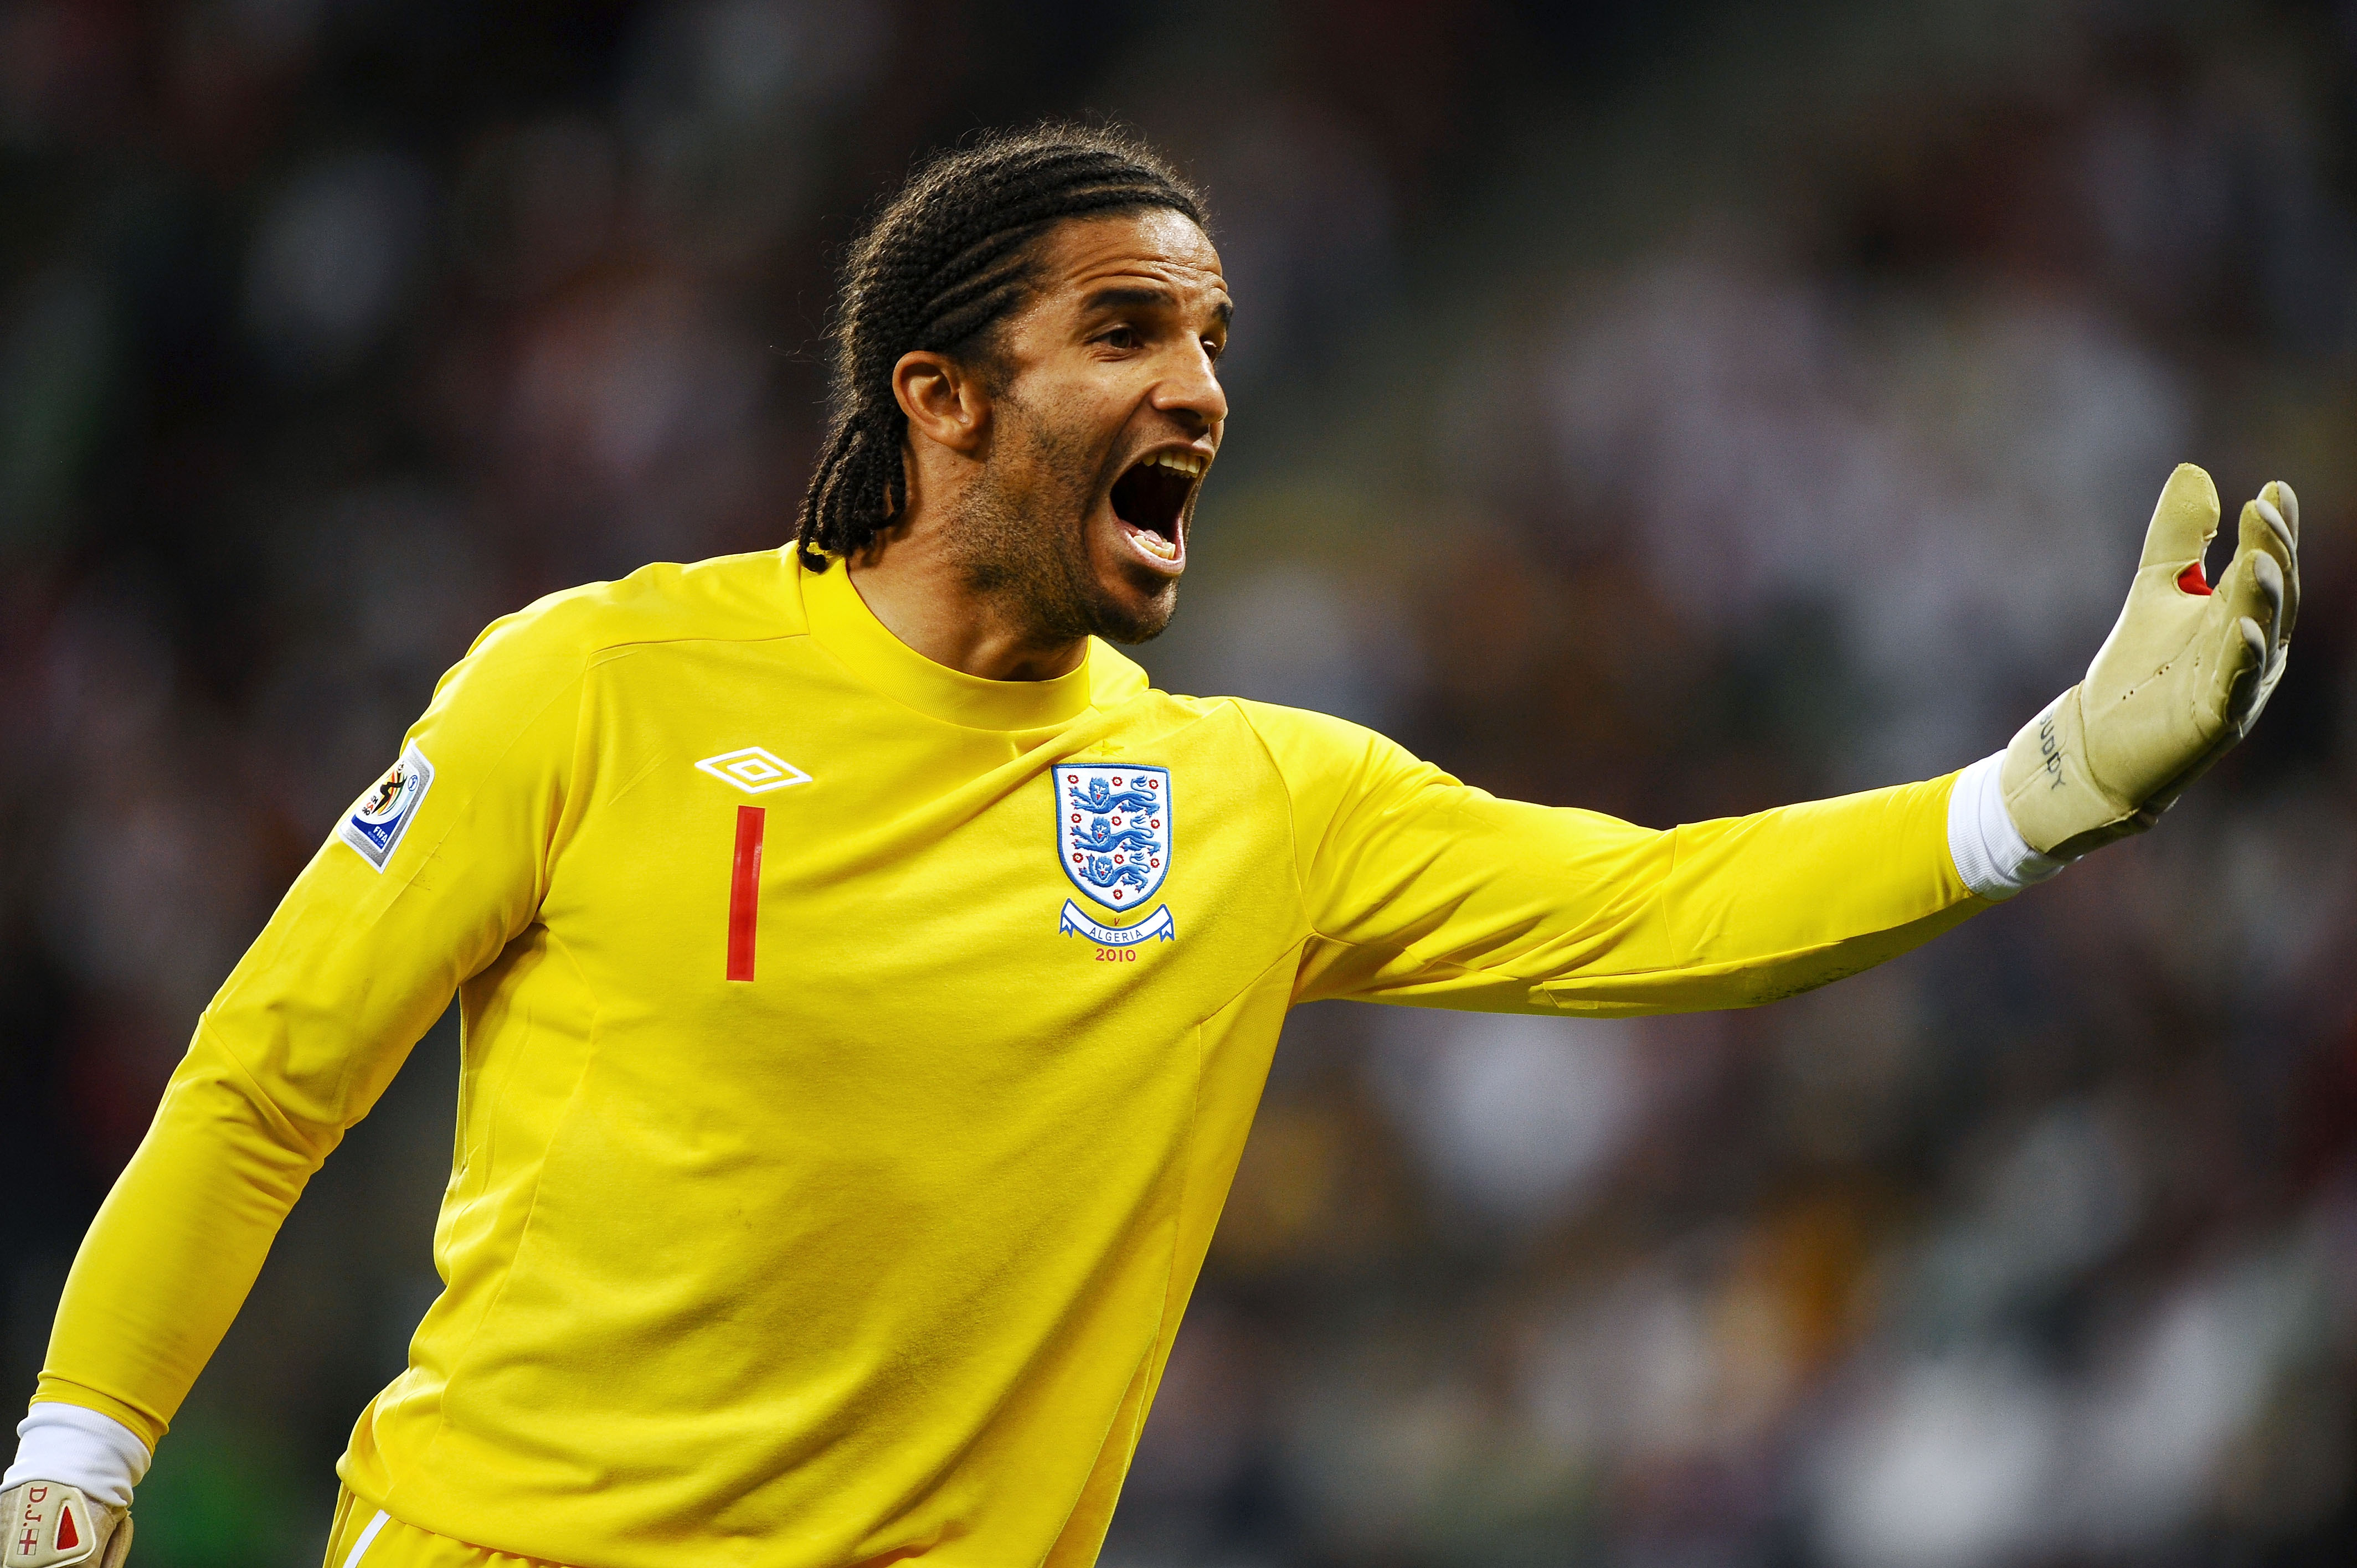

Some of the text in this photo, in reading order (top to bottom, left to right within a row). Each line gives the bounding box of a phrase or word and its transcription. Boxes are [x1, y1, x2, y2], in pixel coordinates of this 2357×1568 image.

[373, 826, 388, 843] FIFA
[726, 805, 766, 982] 1
[1089, 927, 1143, 942] ALGERIA
[1095, 948, 1136, 962] 2010
